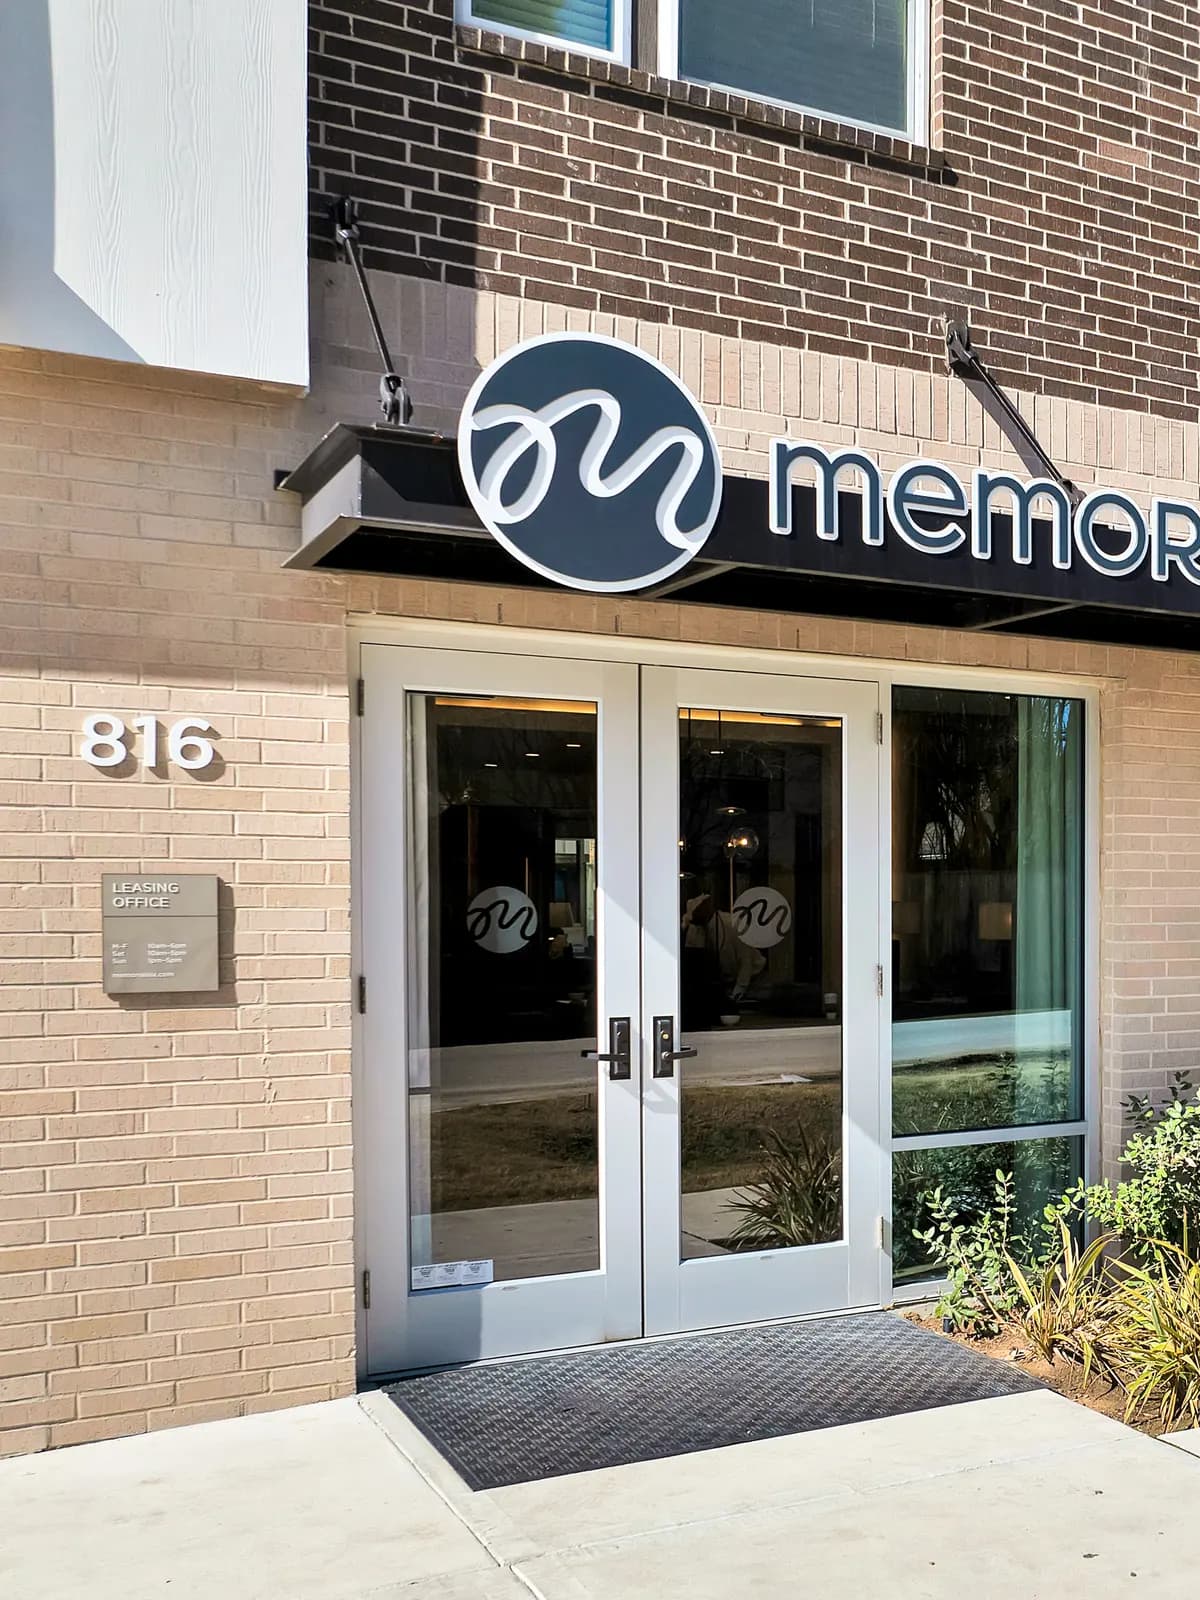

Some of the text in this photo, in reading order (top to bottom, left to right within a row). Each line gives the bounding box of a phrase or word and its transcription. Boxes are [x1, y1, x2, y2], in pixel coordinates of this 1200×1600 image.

[79, 713, 215, 770] 816
[112, 882, 180, 893] LEASING
[112, 897, 170, 908] OFFICE
